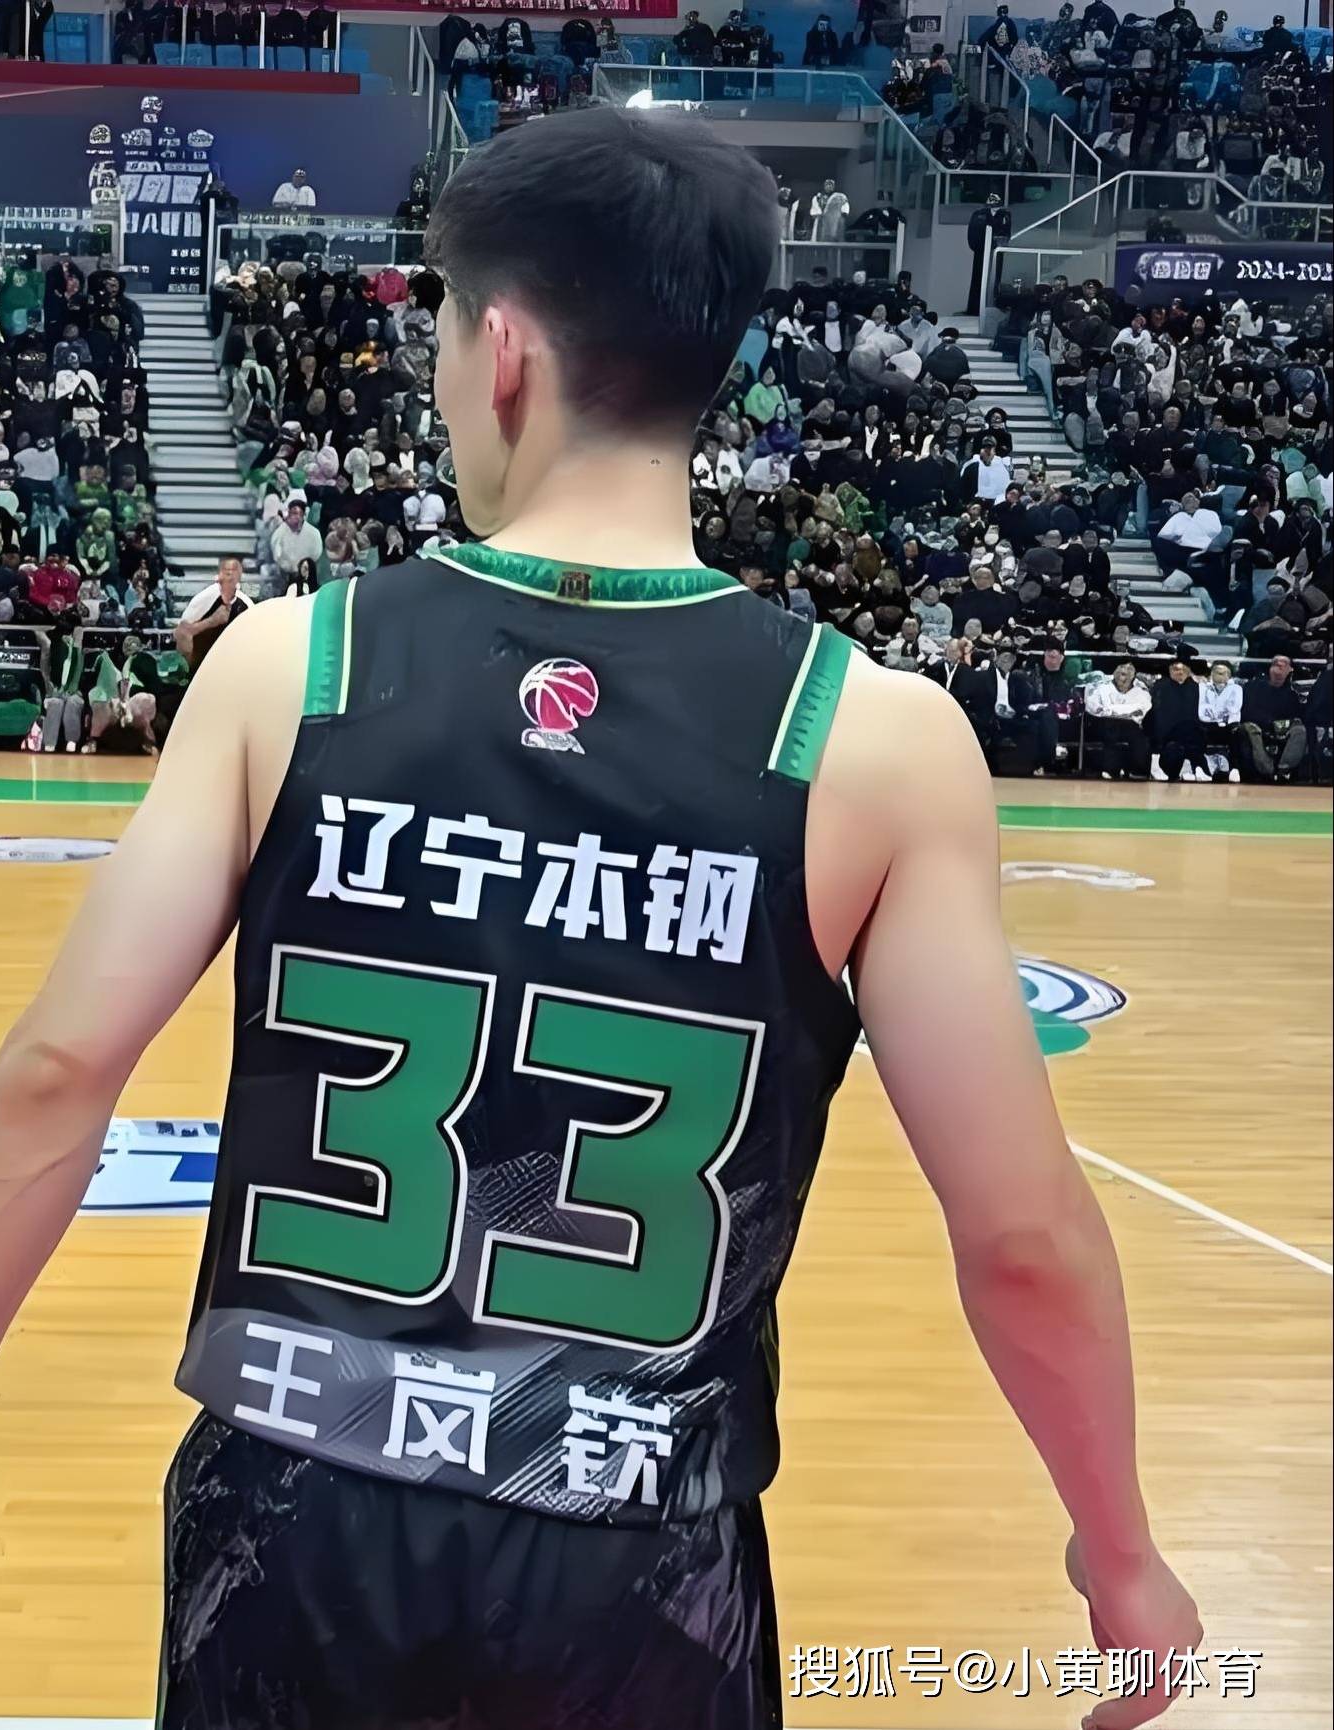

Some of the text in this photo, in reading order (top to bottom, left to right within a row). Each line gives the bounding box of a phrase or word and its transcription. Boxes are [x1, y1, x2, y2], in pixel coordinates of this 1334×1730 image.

[307, 794, 759, 964] 辽宁本钢
[239, 943, 766, 1353] 33
